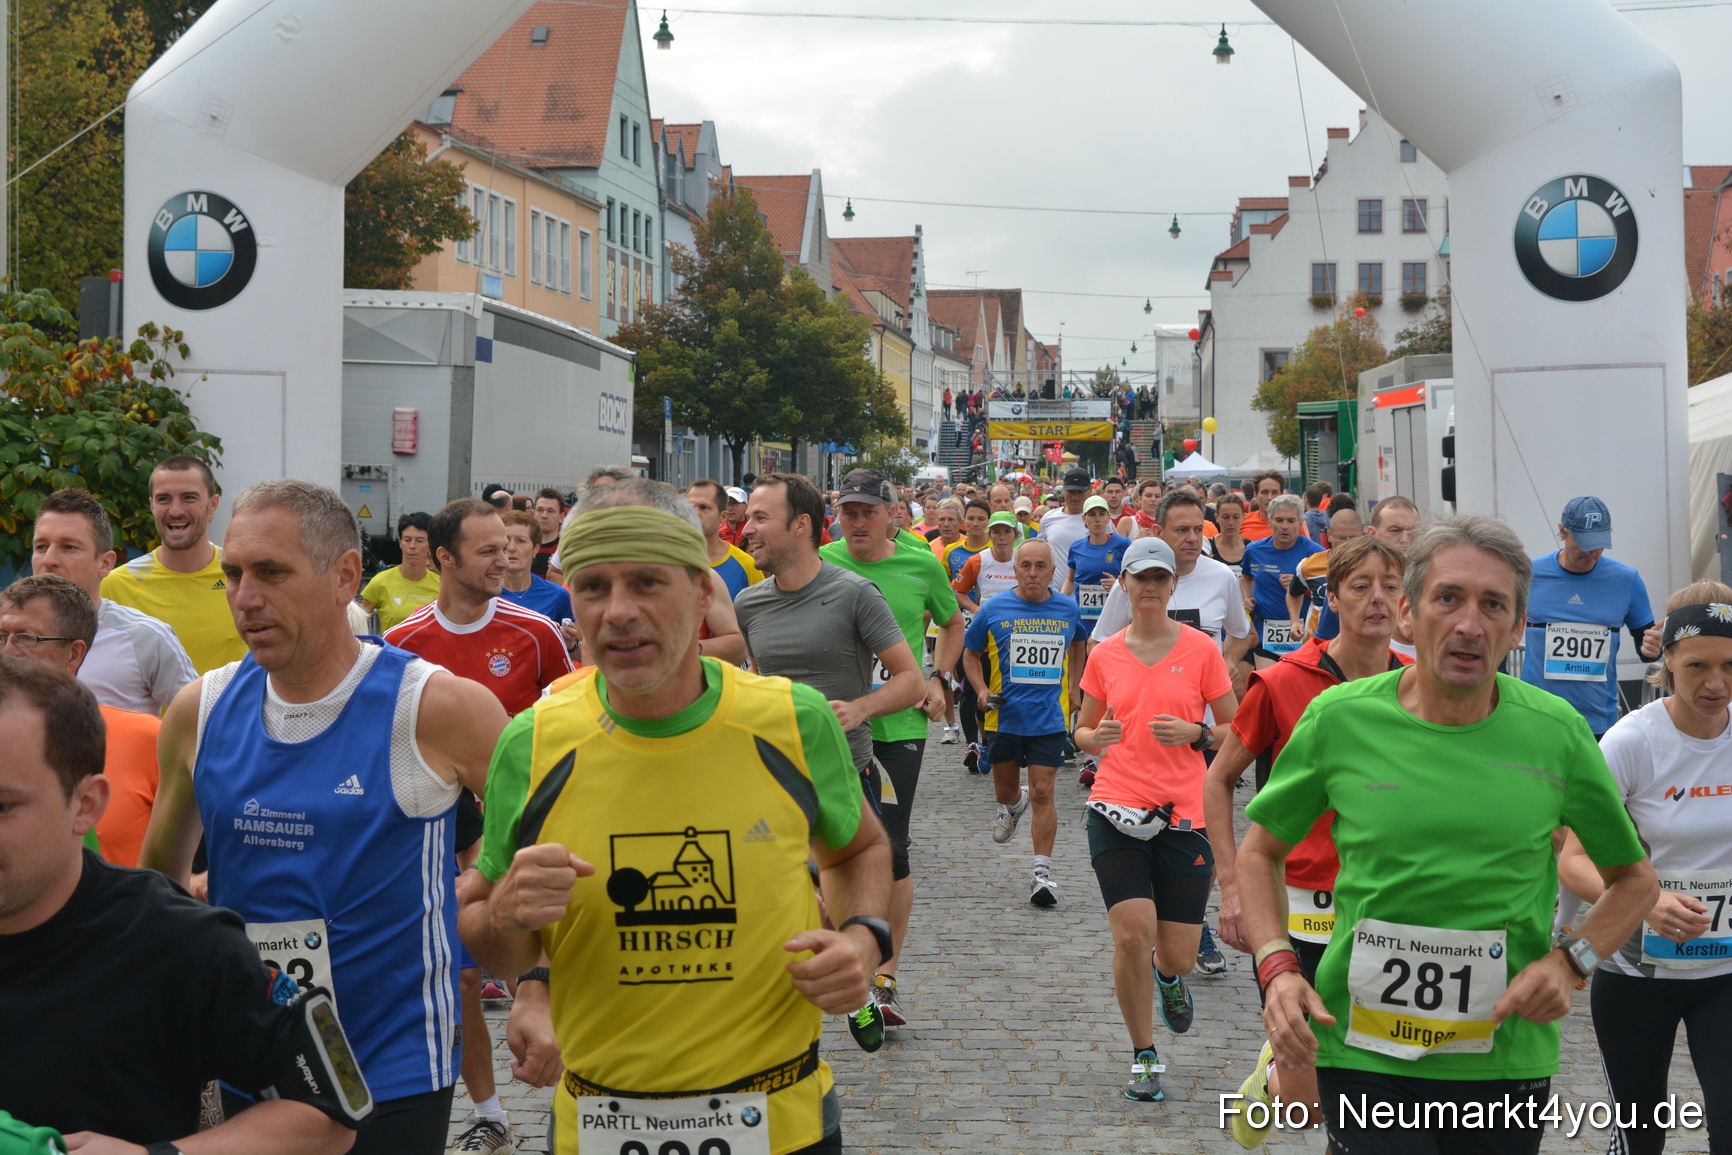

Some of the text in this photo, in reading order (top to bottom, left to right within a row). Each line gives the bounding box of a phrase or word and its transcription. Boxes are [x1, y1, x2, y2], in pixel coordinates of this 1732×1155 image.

[1523, 177, 1629, 220] BMW
[155, 193, 248, 234] BMW
[598, 391, 628, 436] BOCK
[1029, 425, 1072, 436] START
[1000, 618, 1069, 629] 10. NEUMARKTER
[1012, 626, 1061, 634] STADTLAUF
[1571, 628, 1601, 636] Neumarkt
[1267, 629, 1297, 643] 257
[1016, 646, 1060, 665] 2807
[1552, 636, 1605, 659] 2907
[1029, 669, 1045, 678] Gerd
[1565, 662, 1590, 673] Armin
[1689, 785, 1732, 798] KLE
[260, 808, 306, 821] Zimmerei
[233, 818, 315, 836] RAMSAUER
[243, 834, 305, 851] Allersberg
[618, 929, 735, 952] HIRSCH
[1357, 931, 1483, 958] PARTL Neumarkt
[1674, 942, 1728, 956] Kerstin
[620, 962, 733, 976] APOTHEKE
[1380, 957, 1472, 1014] 281
[1390, 1019, 1456, 1047] Jürgen
[296, 1053, 321, 1095] runtastic
[1529, 1079, 1547, 1090] JAKO
[582, 1111, 734, 1131] PARTL Neumarkt
